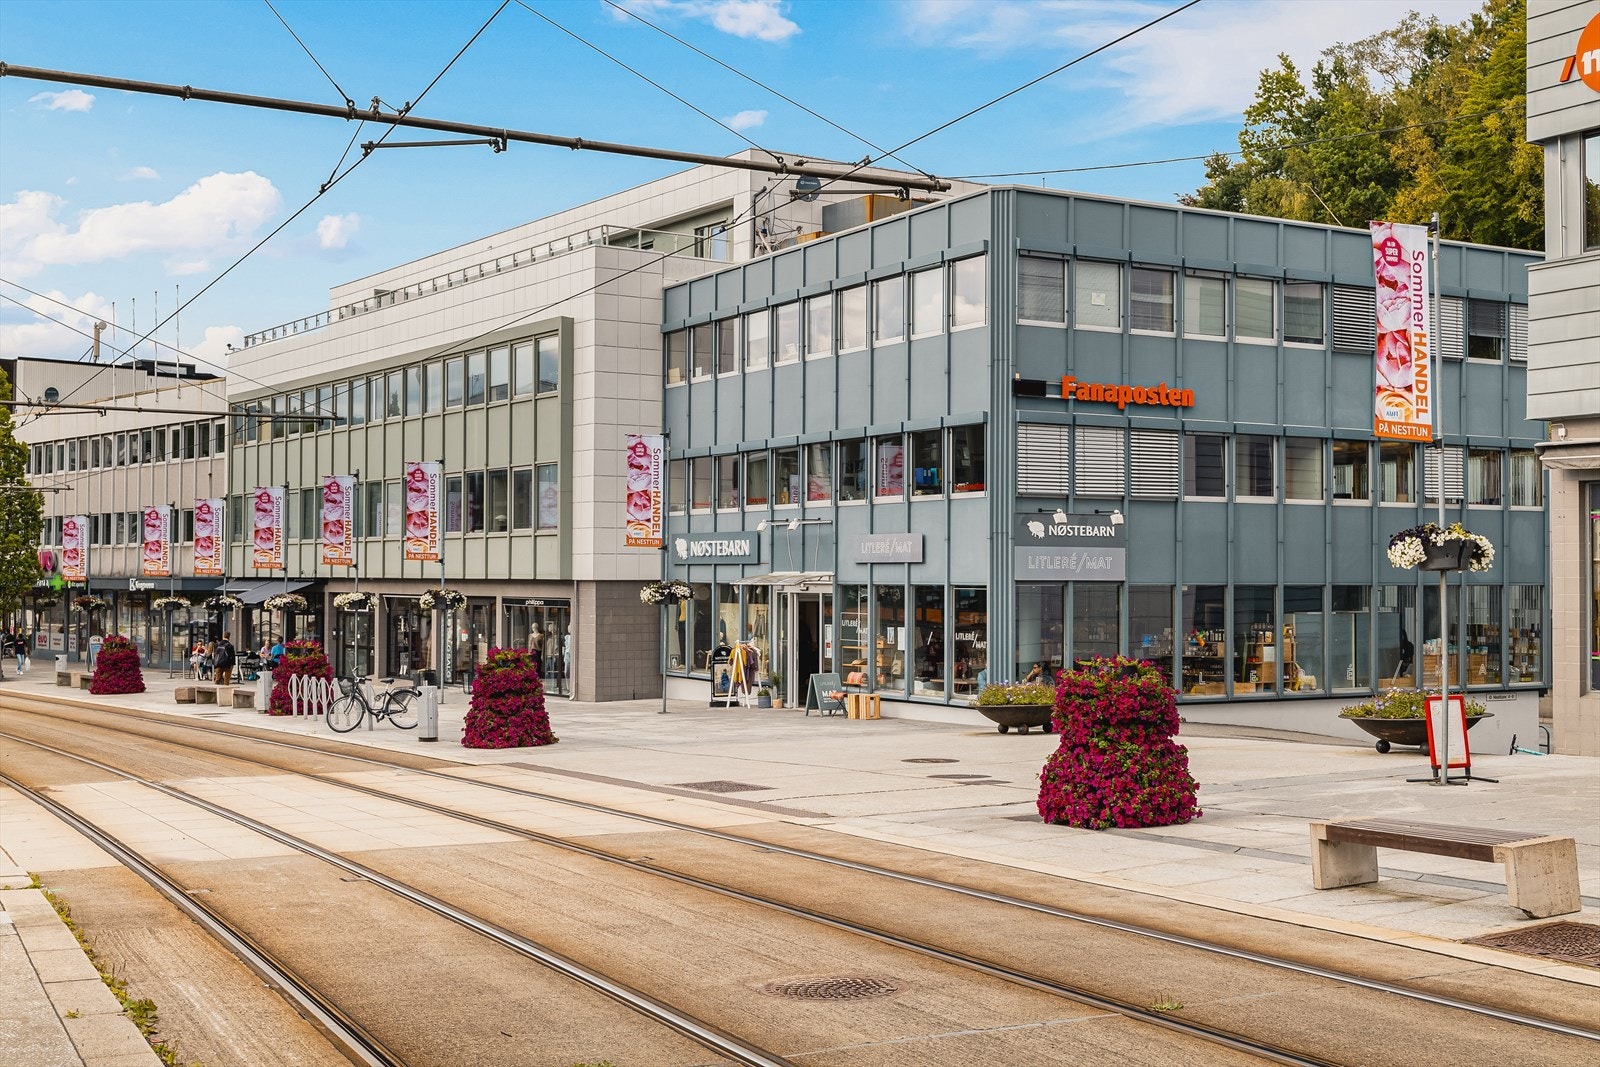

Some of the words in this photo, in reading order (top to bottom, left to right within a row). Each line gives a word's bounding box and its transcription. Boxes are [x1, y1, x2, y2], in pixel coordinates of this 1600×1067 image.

[1061, 375, 1195, 410] Fanaposten
[1378, 423, 1389, 434] PÅ
[1391, 425, 1428, 437] NESTTUN
[1048, 524, 1115, 538] NØSTEBARN
[690, 539, 750, 558] NØSTEBARN
